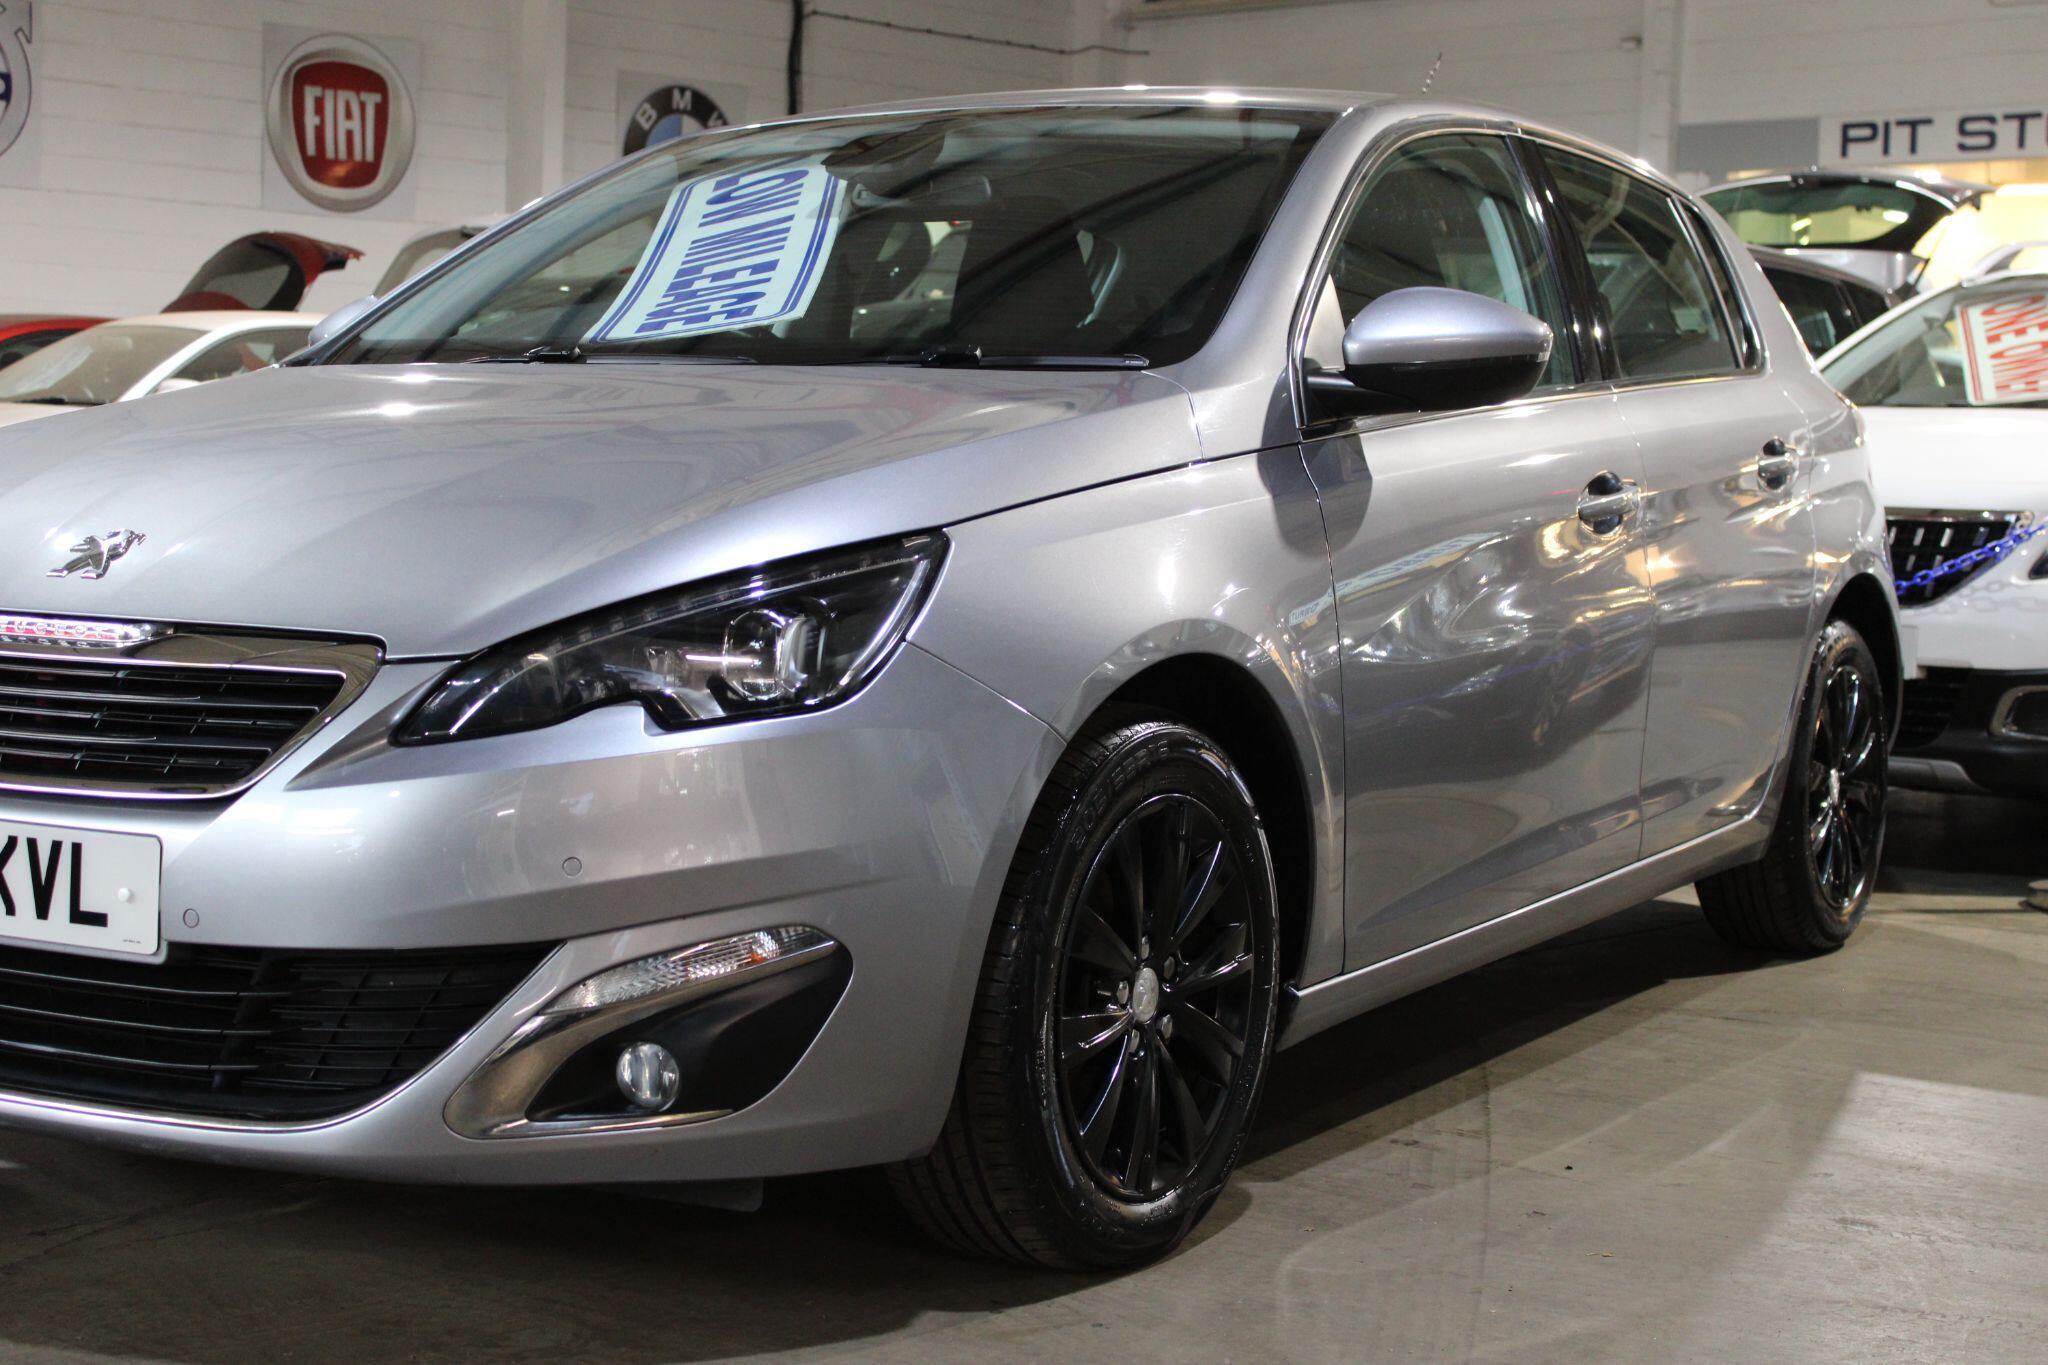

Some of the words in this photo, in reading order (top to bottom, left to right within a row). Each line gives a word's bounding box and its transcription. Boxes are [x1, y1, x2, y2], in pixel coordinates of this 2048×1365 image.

[303, 84, 382, 163] FIAT
[1840, 118, 1934, 158] PIT
[1957, 112, 2048, 153] ST
[634, 213, 796, 335] MILEAGE
